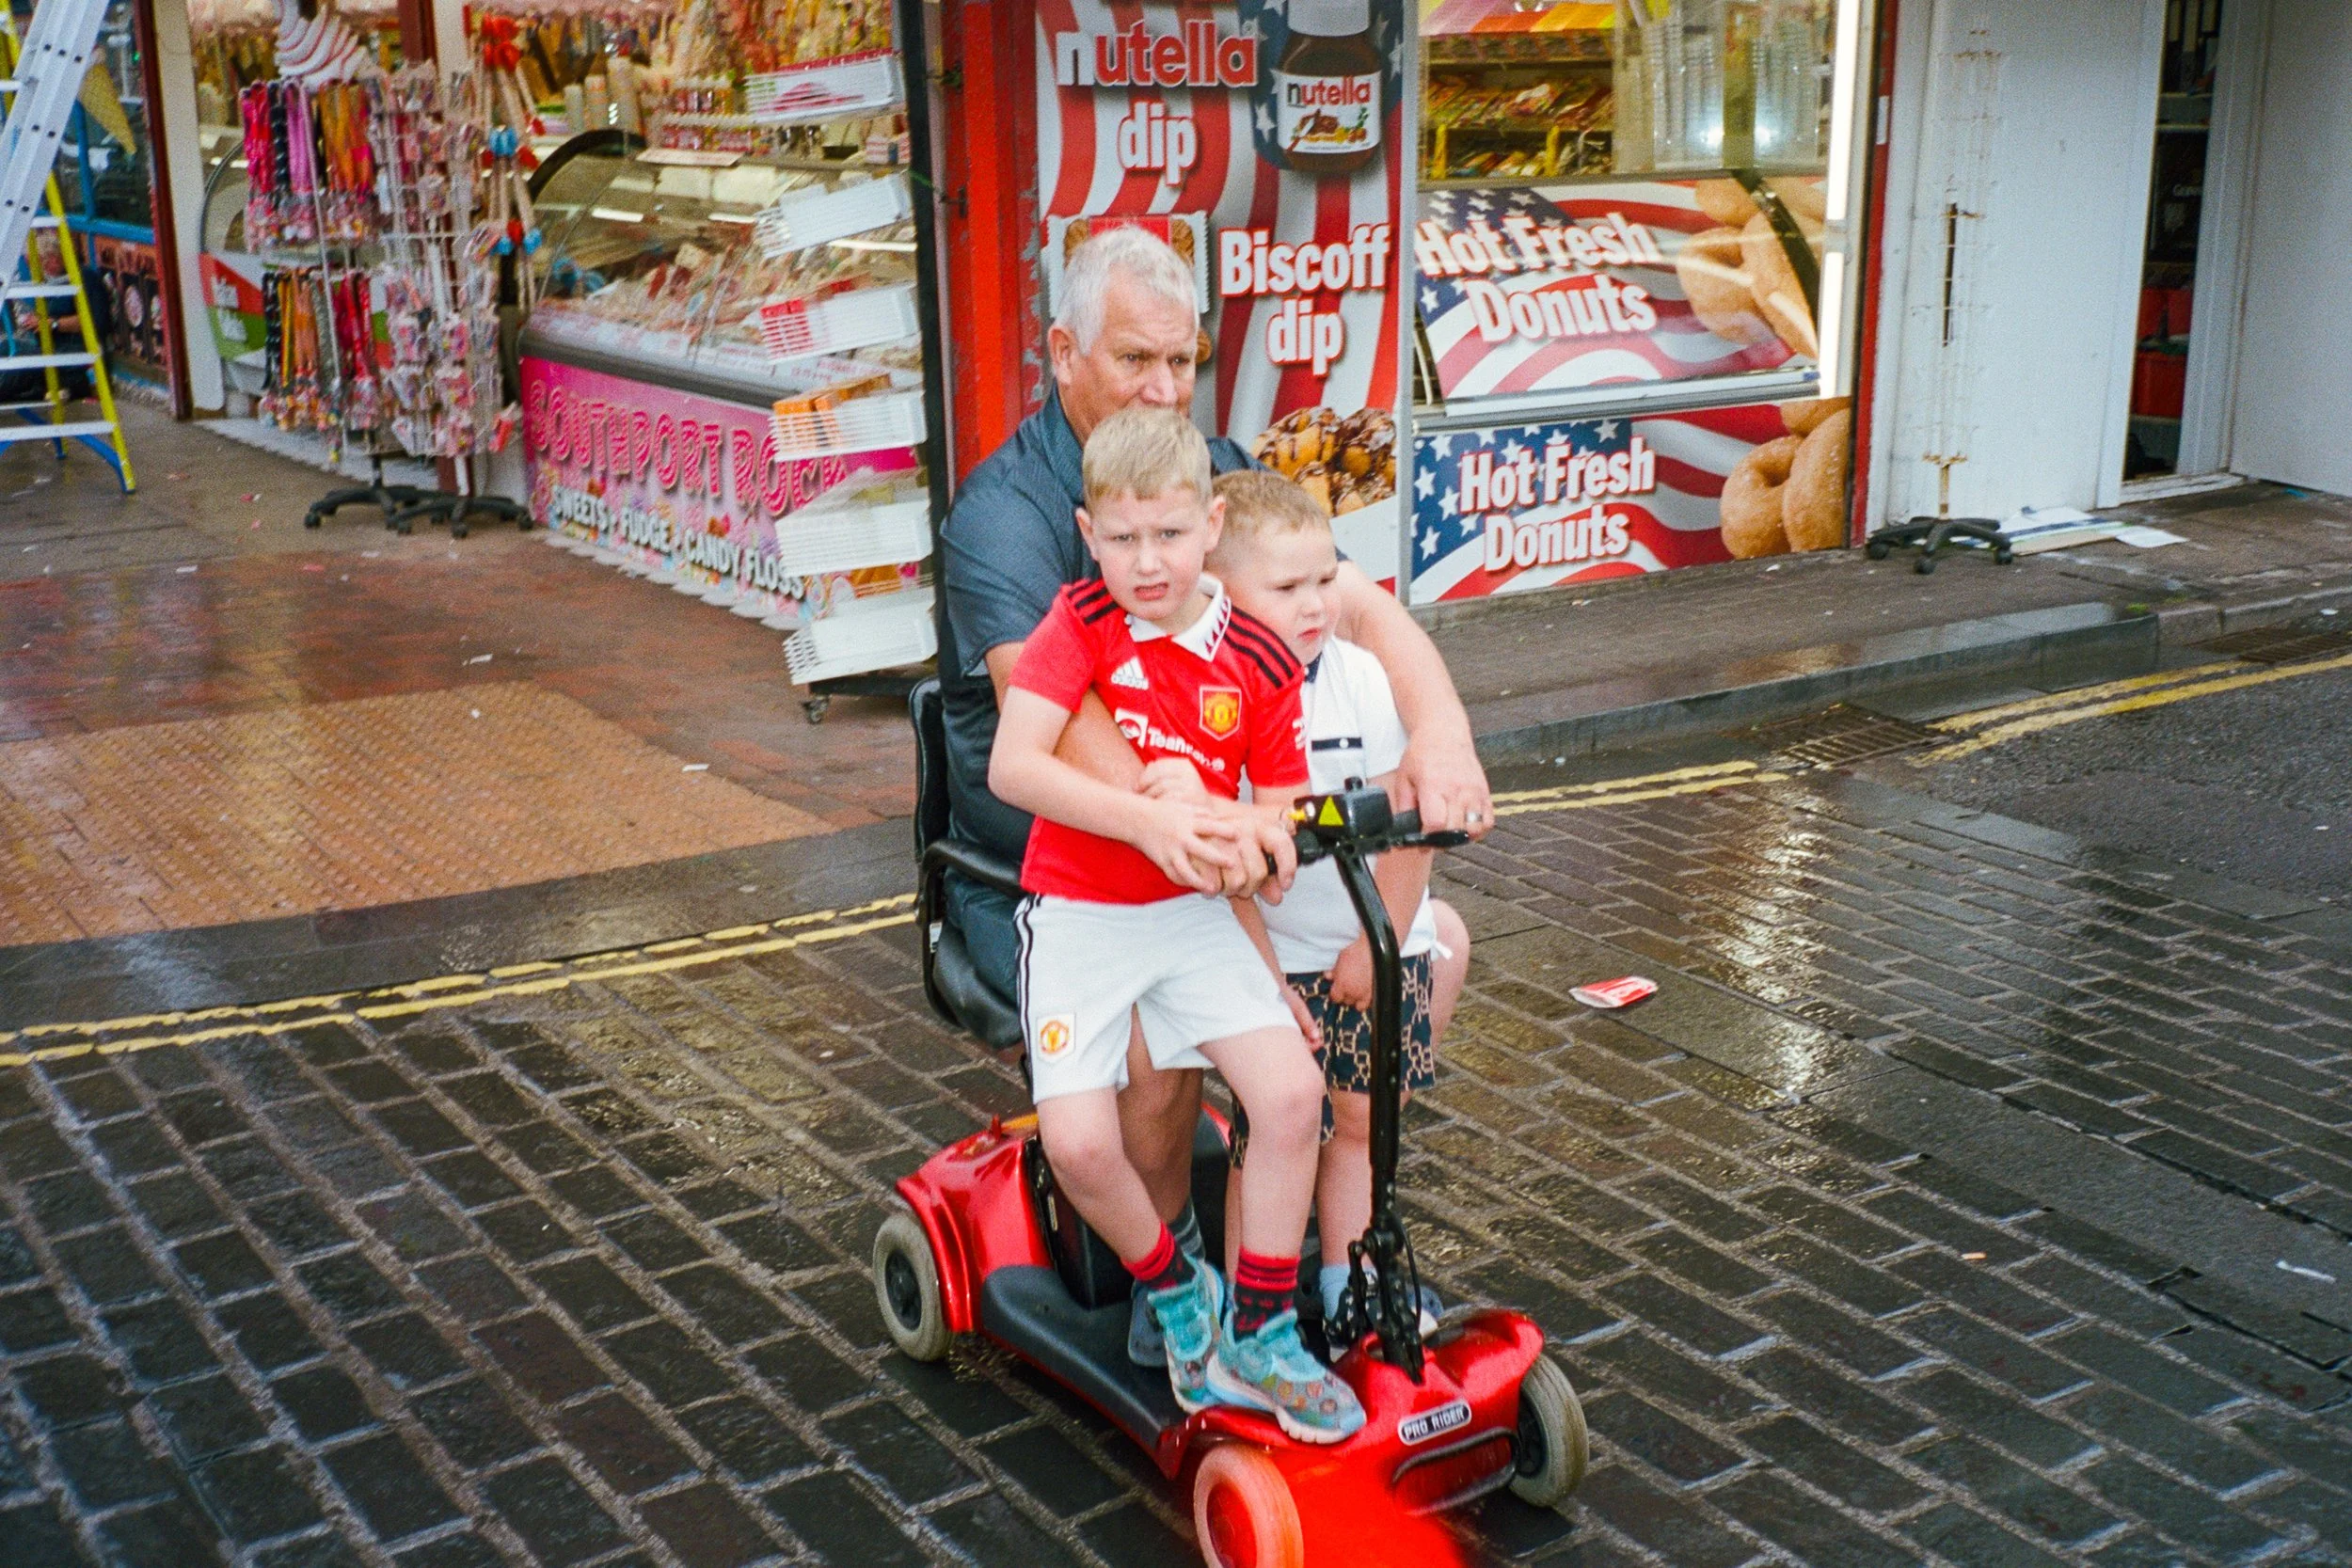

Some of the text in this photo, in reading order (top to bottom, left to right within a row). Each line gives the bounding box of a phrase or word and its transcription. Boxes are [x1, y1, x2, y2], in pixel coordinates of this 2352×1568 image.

[1056, 18, 1258, 87] nutella
[1287, 75, 1371, 105] nutella
[1118, 100, 1199, 187] dip
[1219, 225, 1392, 297] Biscoff
[1415, 212, 1662, 279] Hot Fresh
[1267, 296, 1344, 377] dip
[1465, 275, 1659, 343] Donuts
[530, 378, 723, 499] SOUTHPORT
[1458, 436, 1657, 515] Hot Fresh
[553, 484, 805, 600] SWEETS FUDGE CANDY FLOSS
[1483, 503, 1631, 574] Donuts
[1403, 1404, 1465, 1441] PRO RIDER
